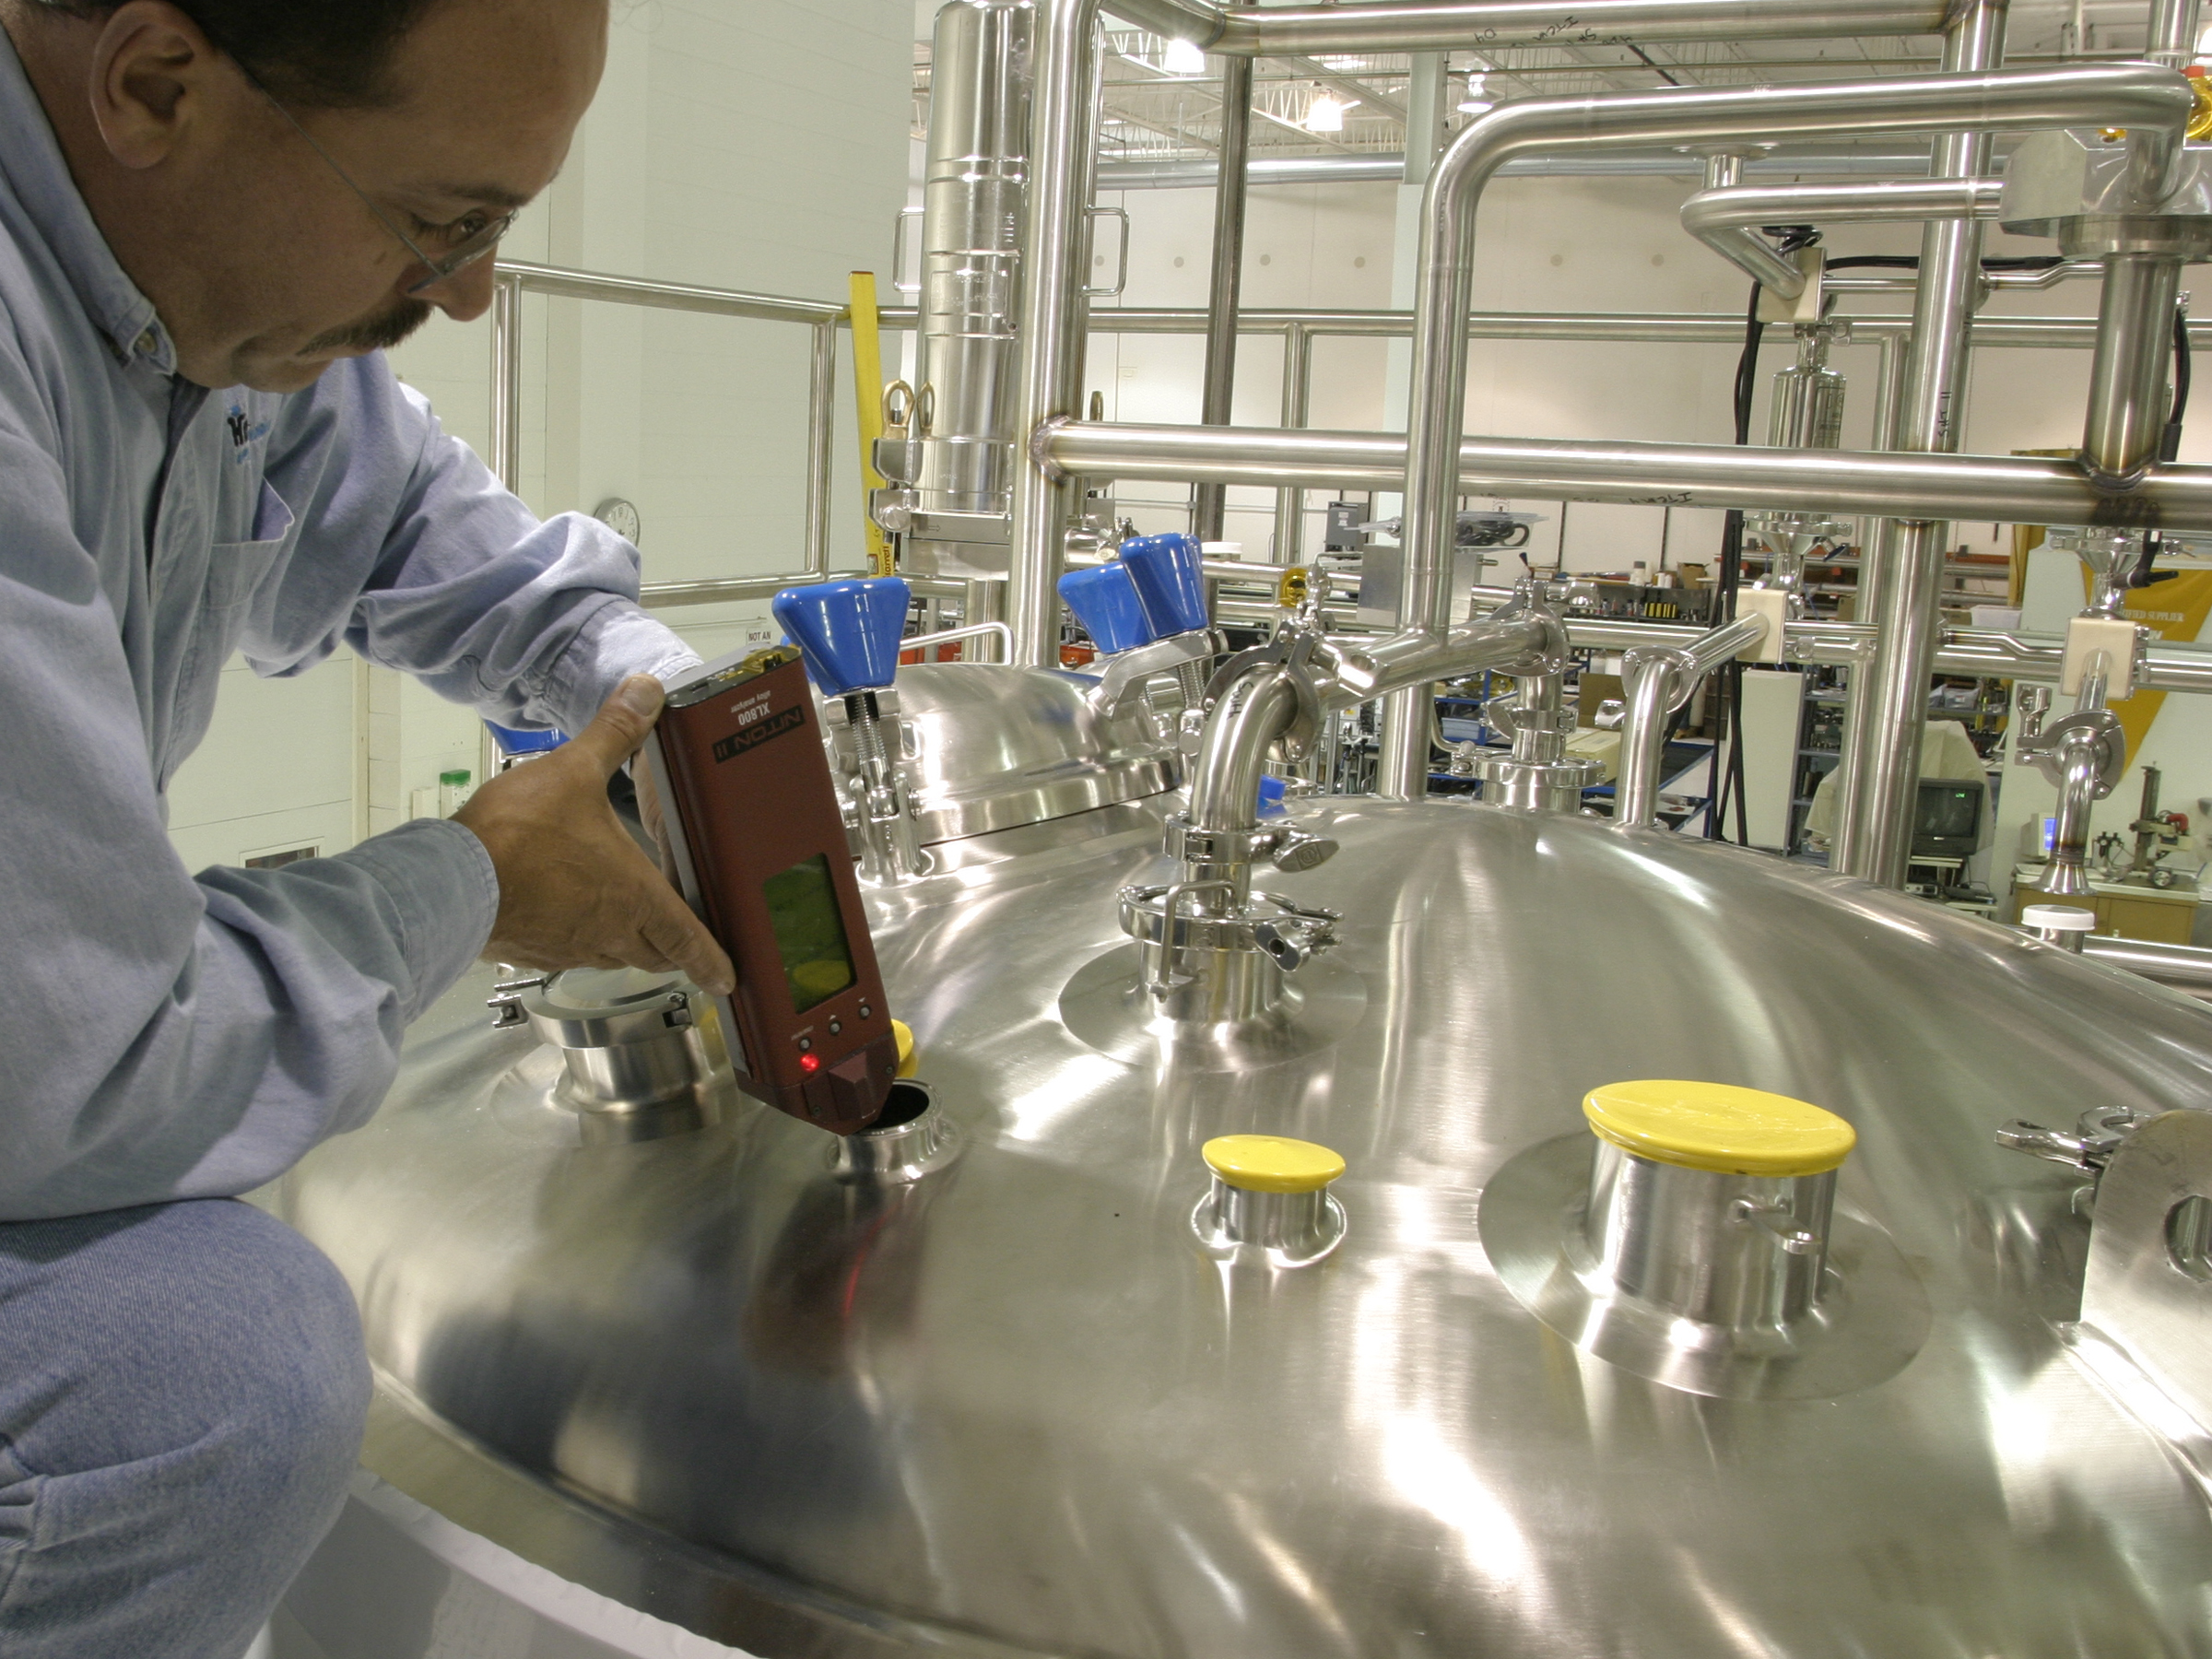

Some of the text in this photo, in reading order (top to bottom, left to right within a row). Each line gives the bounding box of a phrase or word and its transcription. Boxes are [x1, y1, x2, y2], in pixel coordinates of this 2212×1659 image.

[748, 630, 771, 641] NOT AN
[731, 690, 771, 712] alloy analyzer
[738, 702, 771, 725] XL800
[734, 709, 801, 750] NITON
